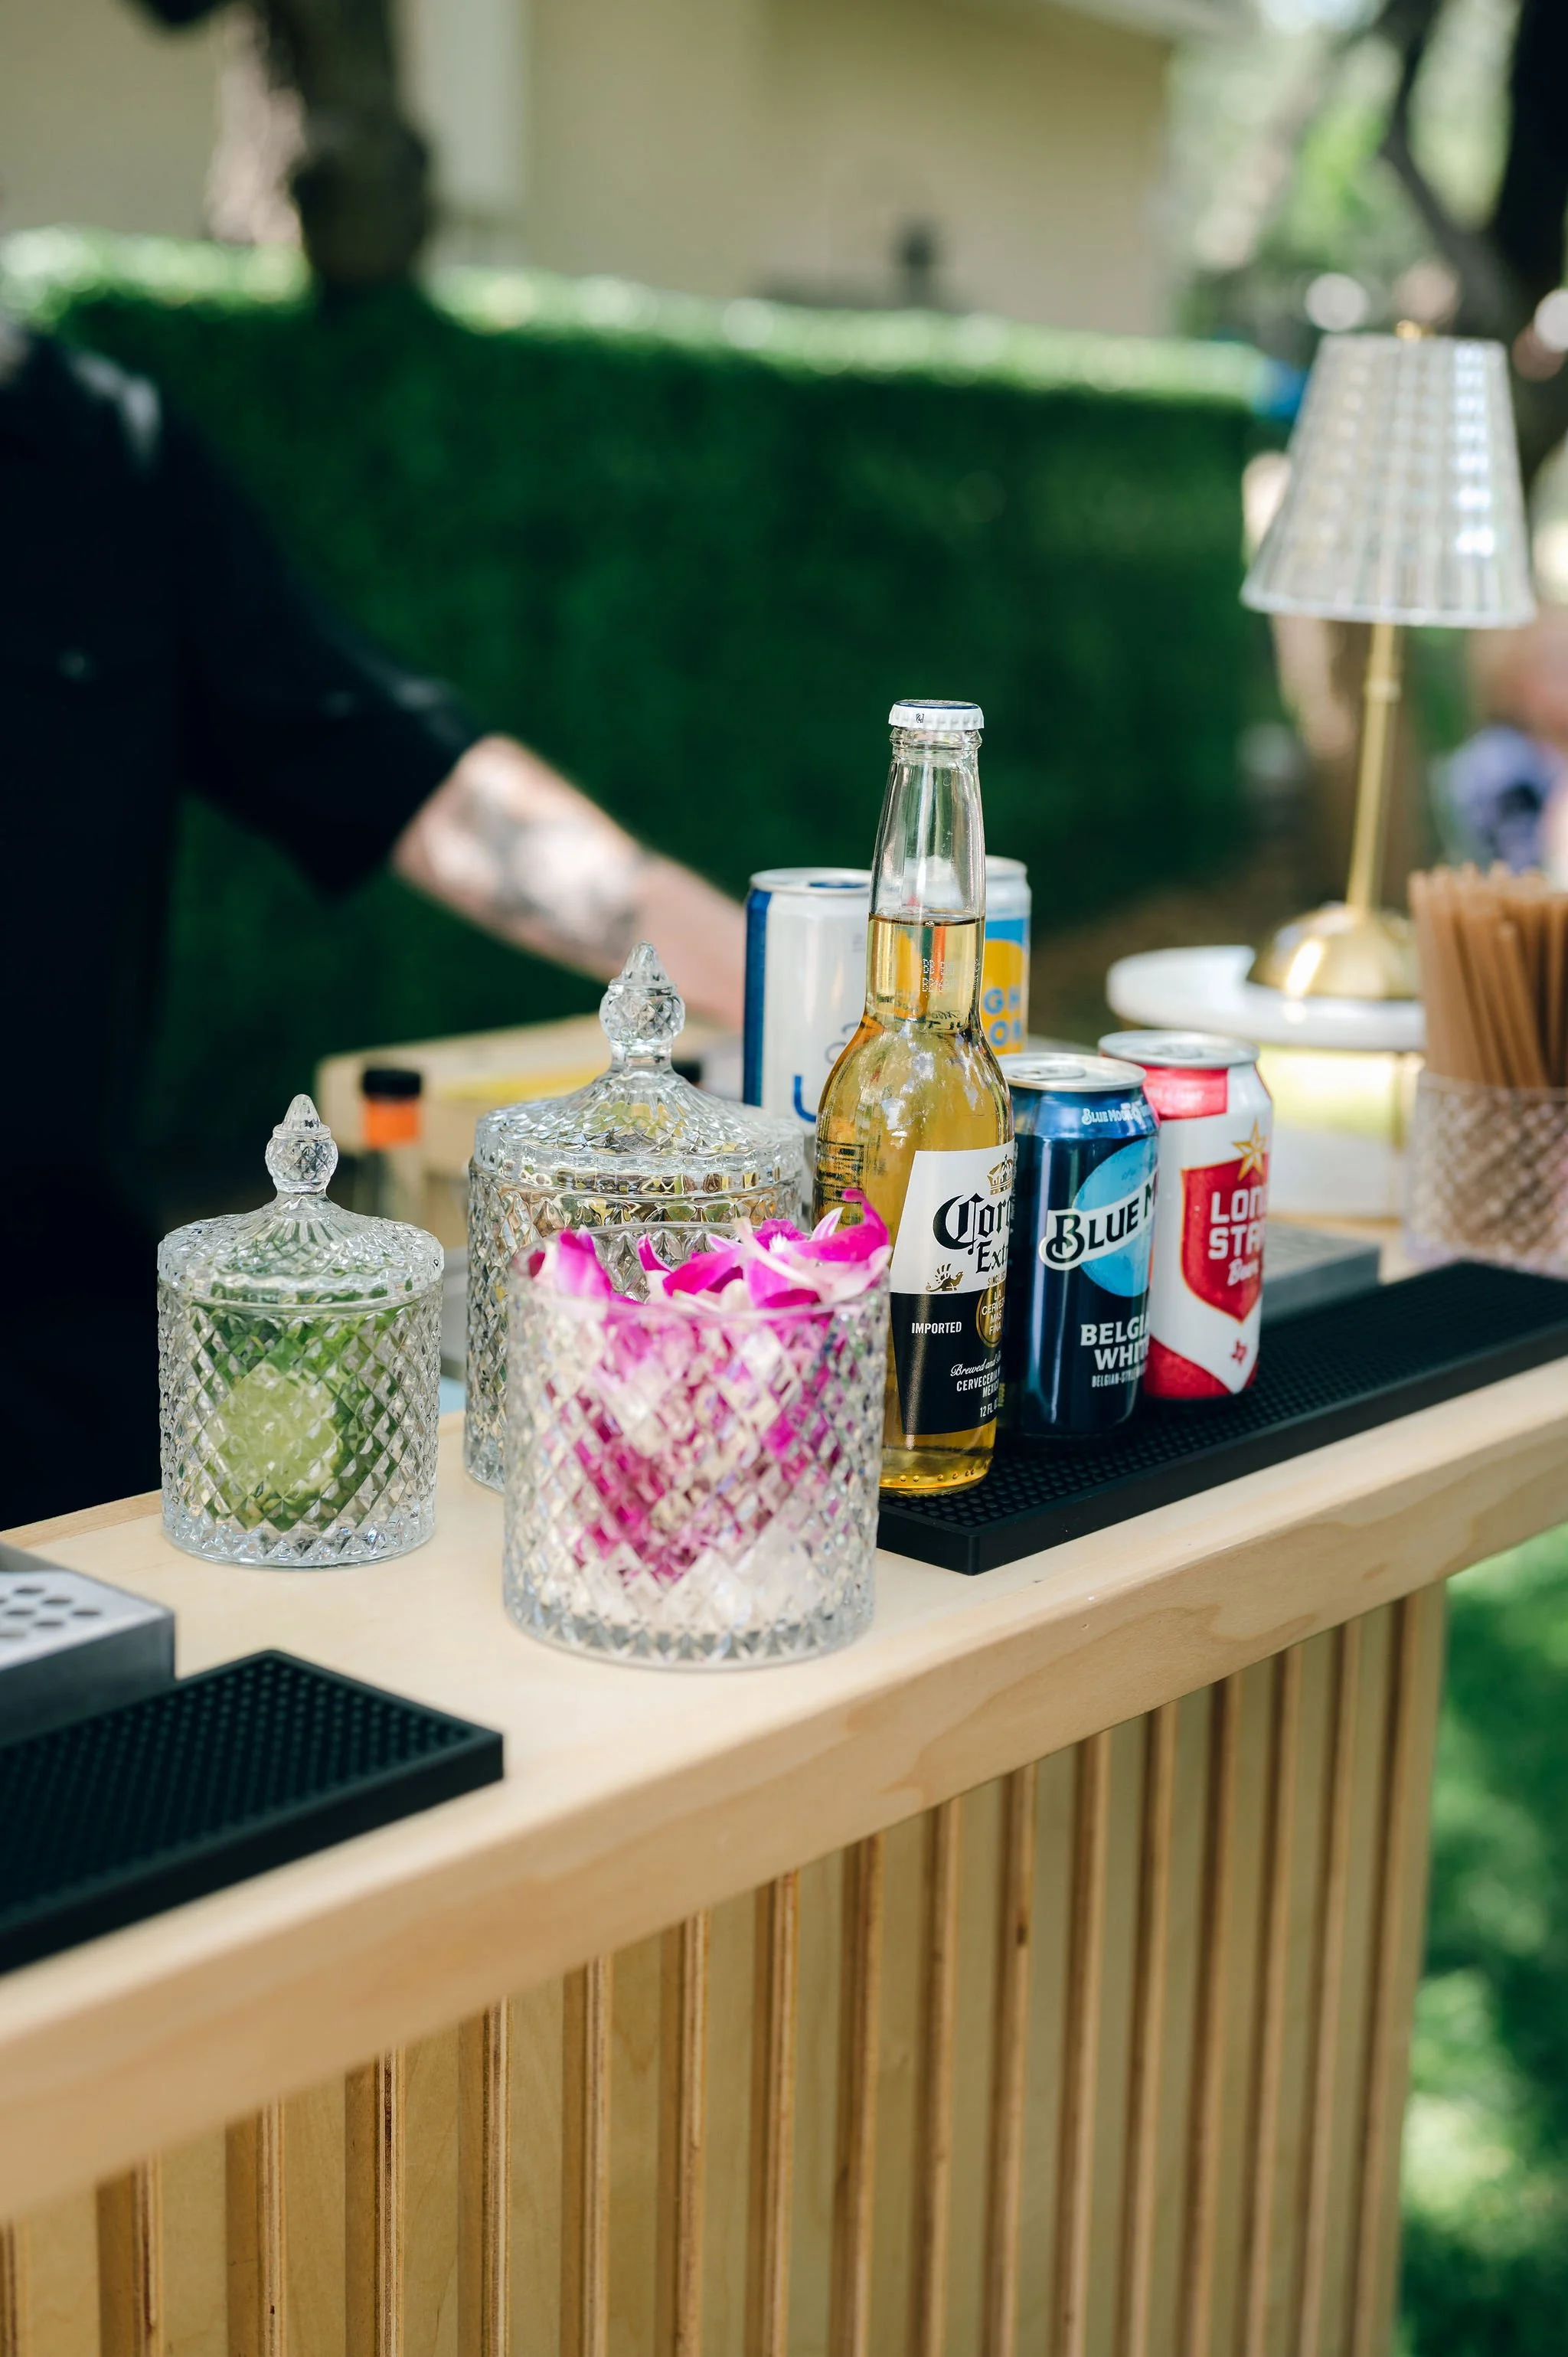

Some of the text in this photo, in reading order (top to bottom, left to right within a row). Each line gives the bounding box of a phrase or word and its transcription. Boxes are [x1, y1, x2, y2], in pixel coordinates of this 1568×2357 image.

[1082, 1108, 1109, 1126] BLUE
[1210, 1185, 1267, 1224] LON
[1045, 1170, 1159, 1263] BLUE M
[1207, 1218, 1265, 1260] STA
[911, 1321, 962, 1334] IMPORTED
[950, 1358, 987, 1377] Brewed
[979, 1405, 986, 1417] 12
